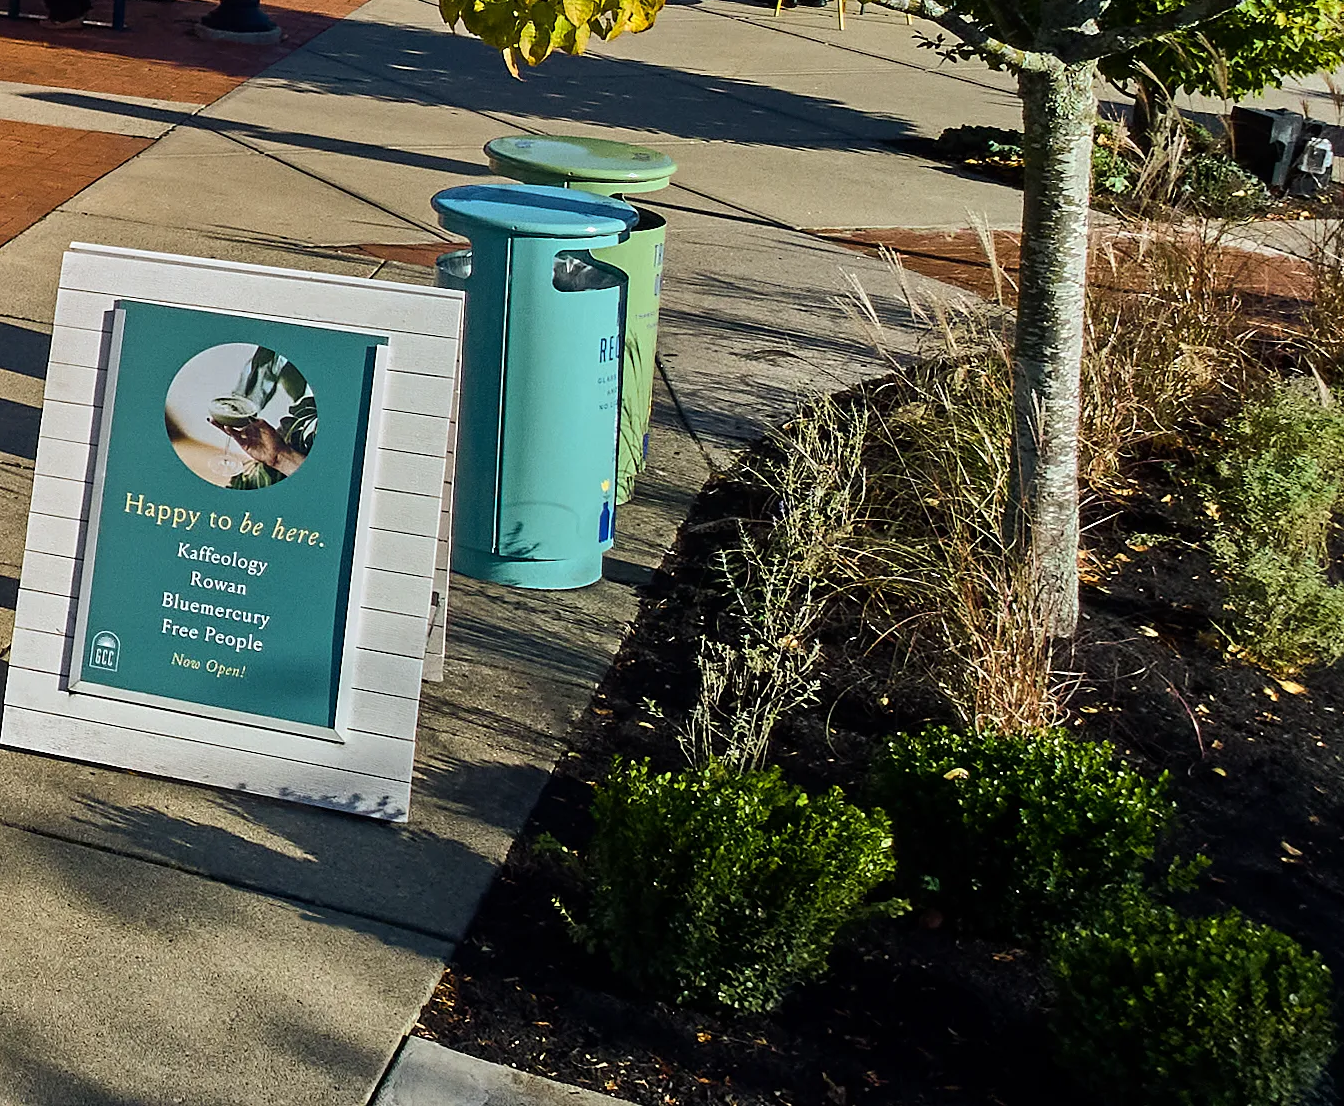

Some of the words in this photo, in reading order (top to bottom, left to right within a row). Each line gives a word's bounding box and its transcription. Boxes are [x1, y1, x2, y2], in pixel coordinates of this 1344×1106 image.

[124, 492, 201, 530] Happy
[209, 511, 232, 531] to
[239, 512, 264, 537] be
[271, 517, 326, 548] here.
[177, 542, 268, 576] Kaffeology
[190, 570, 247, 596] Rowan
[161, 591, 271, 630] Bluemercury
[161, 618, 199, 640] Free
[204, 626, 264, 653] People
[95, 648, 115, 666] GCC
[170, 652, 201, 671] Now
[205, 658, 246, 678] Open!
